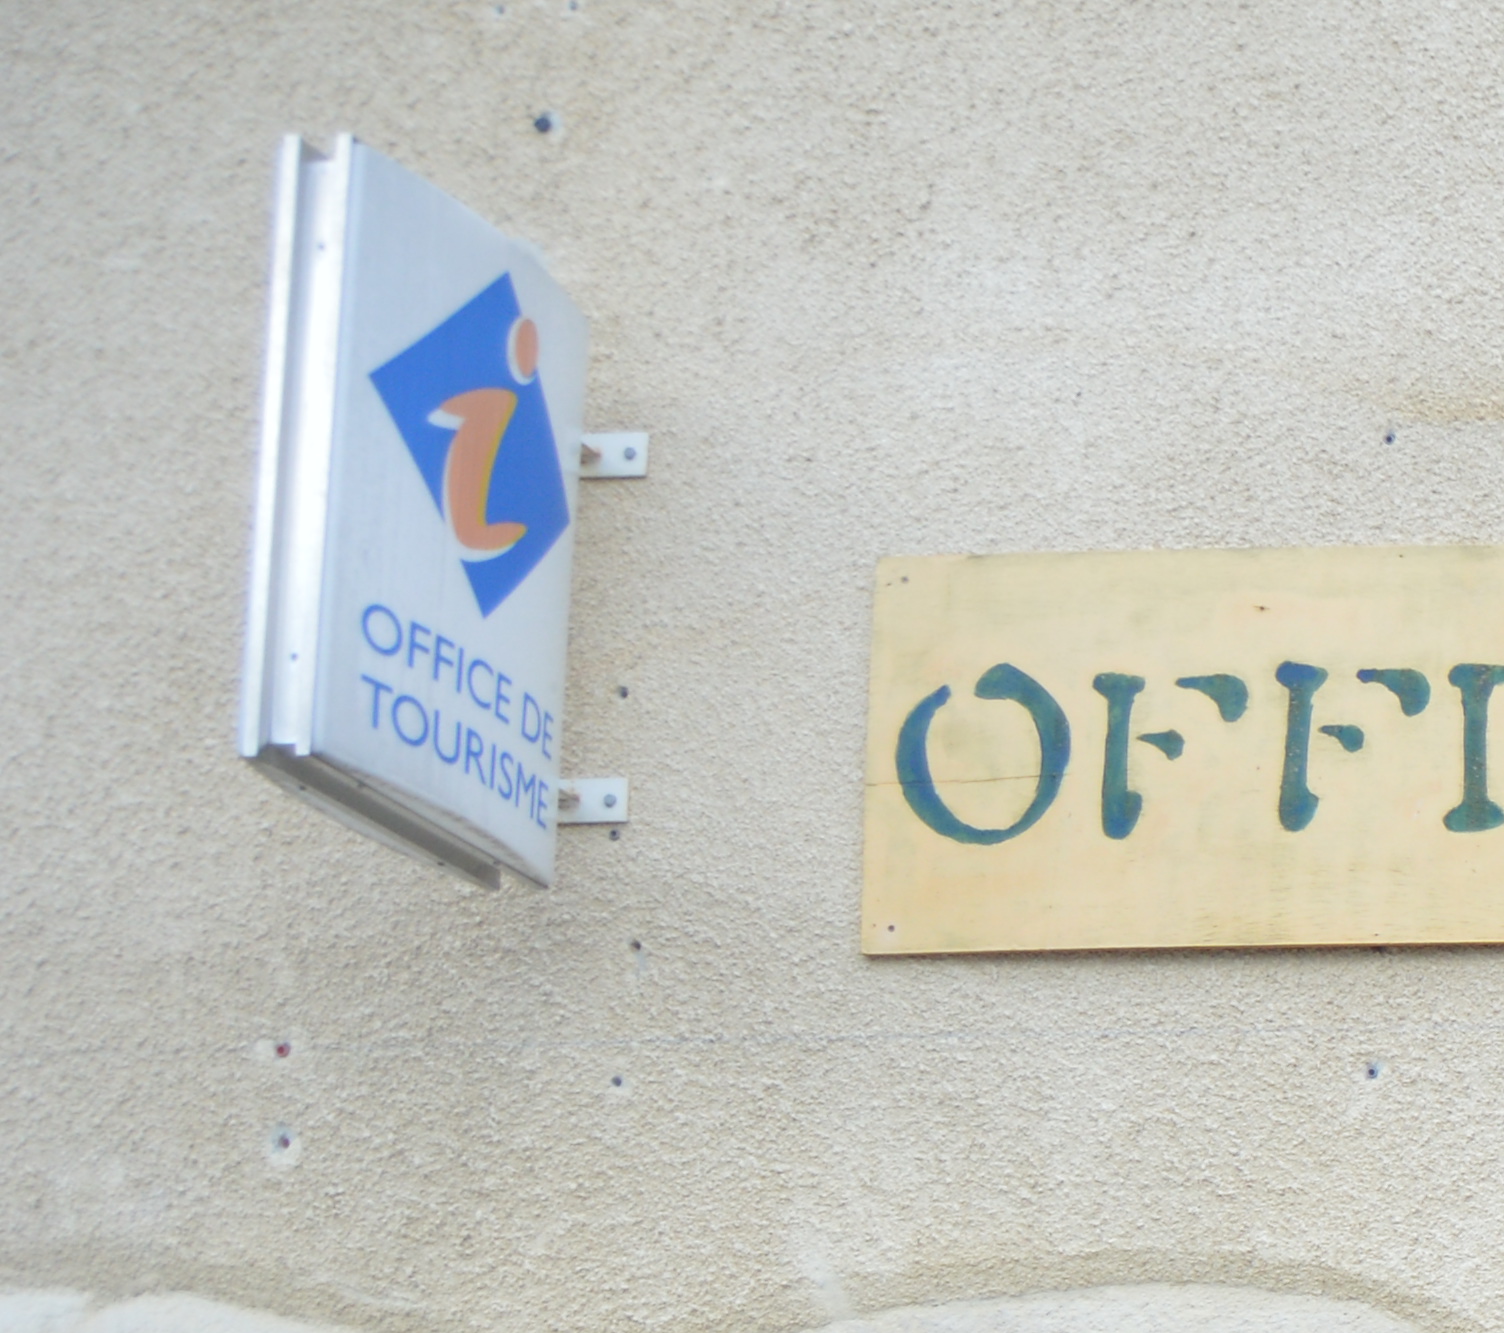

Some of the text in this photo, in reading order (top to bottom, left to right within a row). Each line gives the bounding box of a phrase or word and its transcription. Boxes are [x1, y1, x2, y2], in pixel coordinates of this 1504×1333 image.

[361, 675, 549, 830] TOURISME
[362, 603, 555, 762] OFFICE DE
